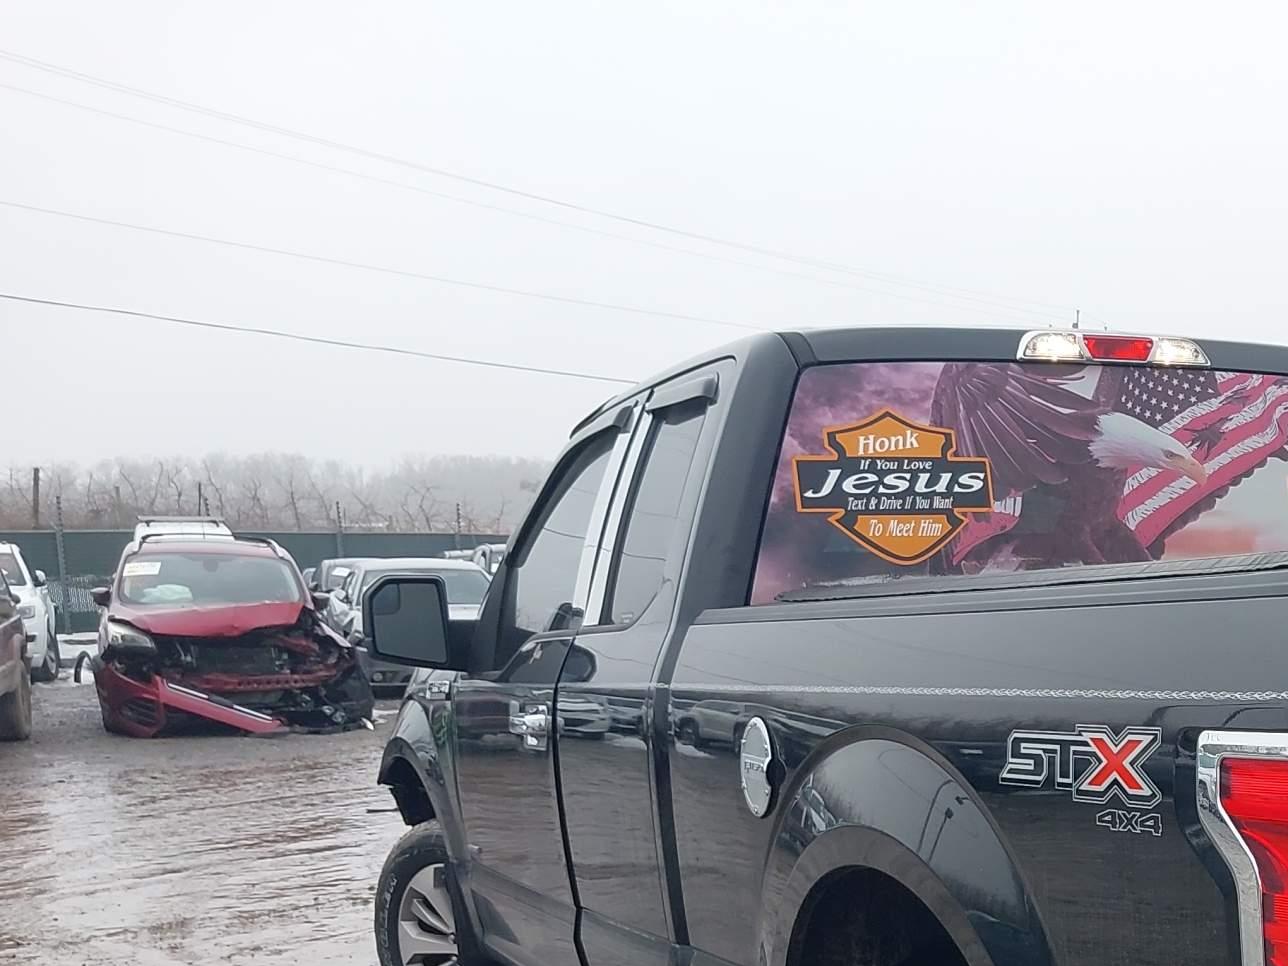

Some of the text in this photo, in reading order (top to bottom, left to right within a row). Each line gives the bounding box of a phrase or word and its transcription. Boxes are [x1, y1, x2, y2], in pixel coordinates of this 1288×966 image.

[858, 430, 920, 456] Honk
[859, 459, 933, 470] If You Love
[803, 469, 985, 498] Jesus
[847, 496, 954, 511] Text & Drive If You Want
[868, 519, 943, 537] To Meet Him
[999, 723, 1162, 809] STX
